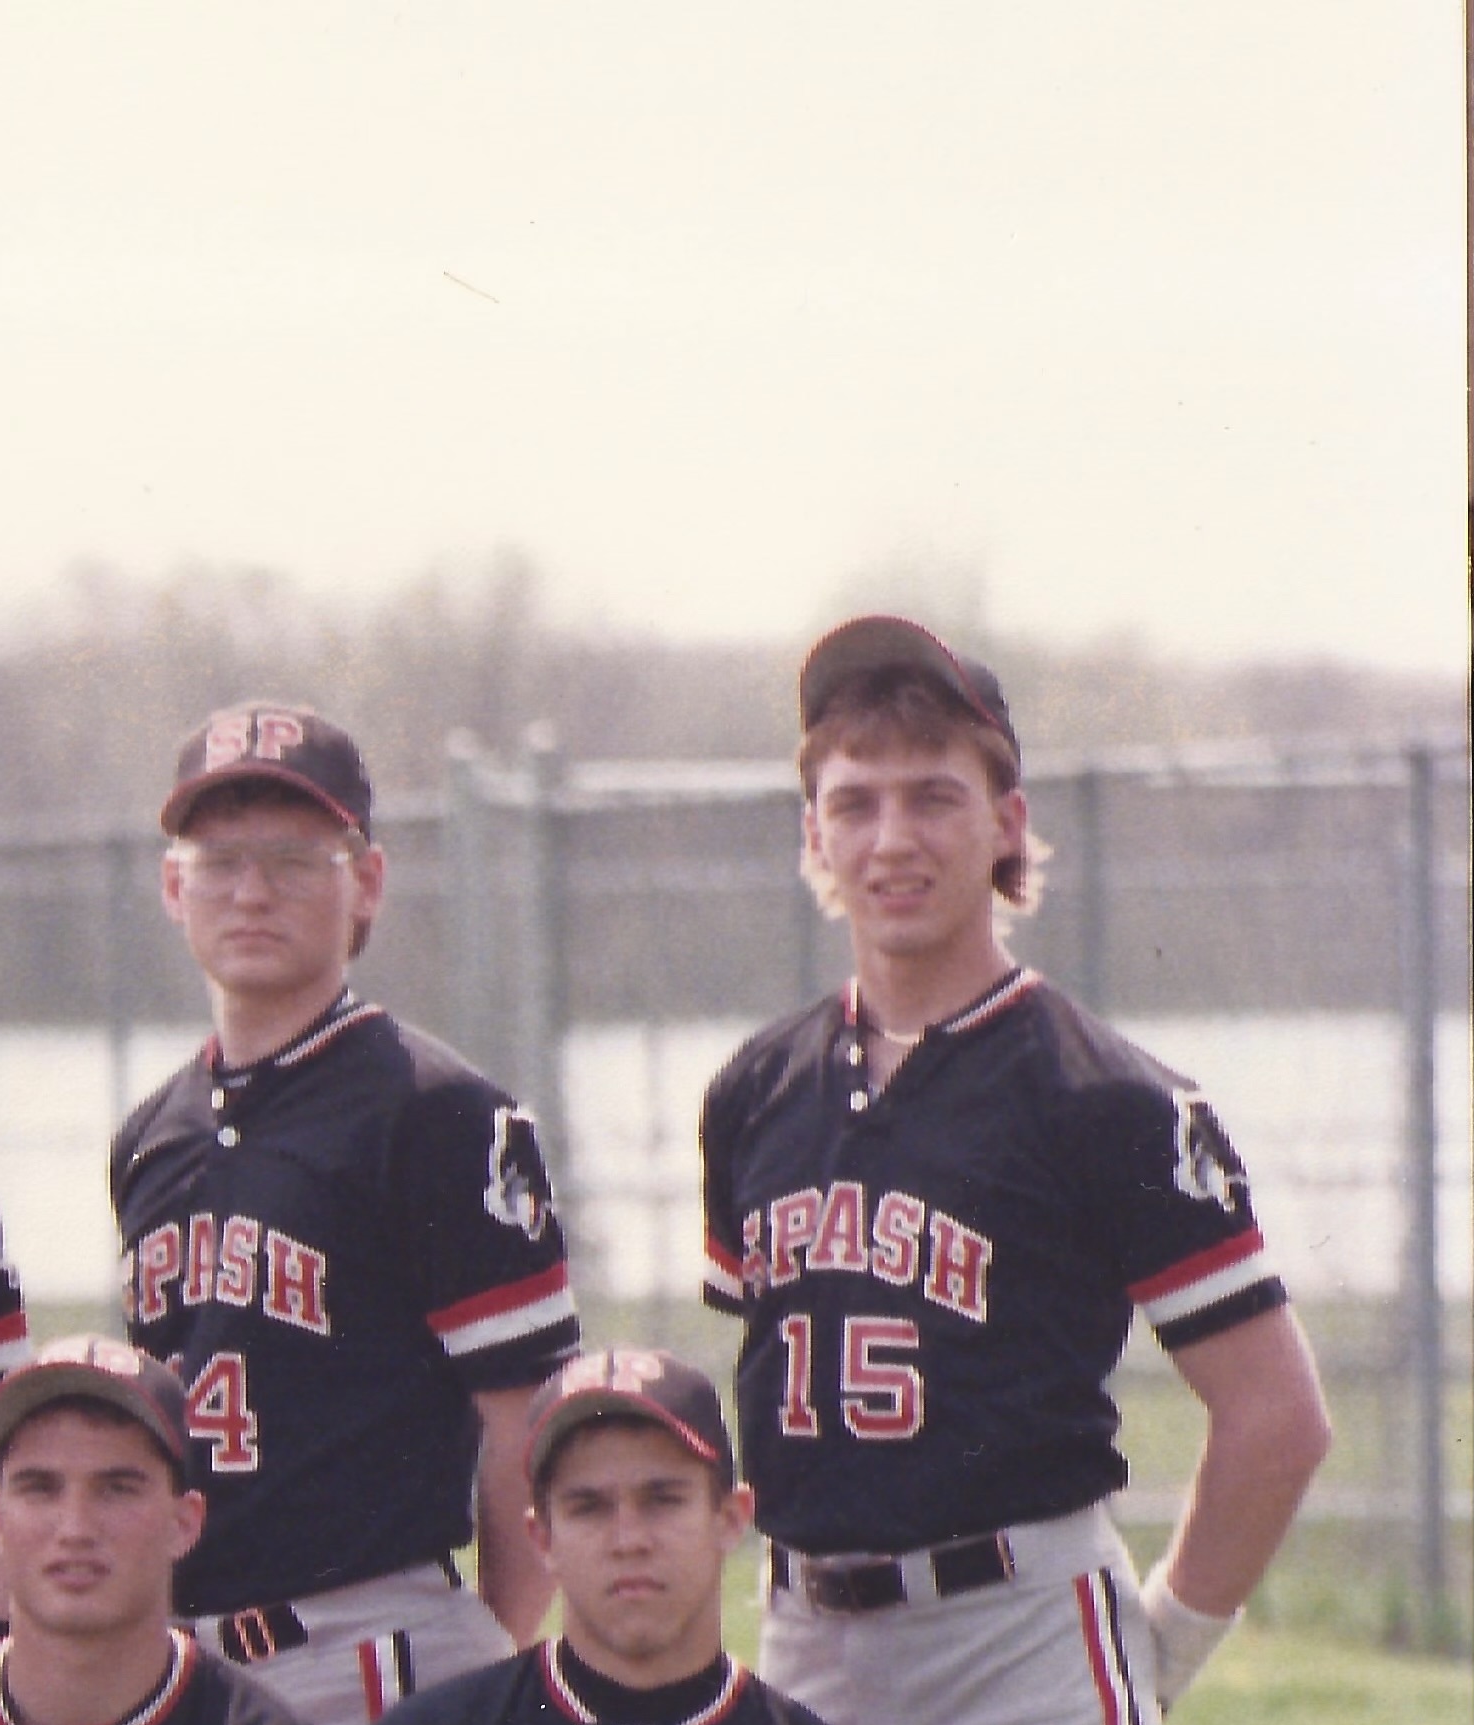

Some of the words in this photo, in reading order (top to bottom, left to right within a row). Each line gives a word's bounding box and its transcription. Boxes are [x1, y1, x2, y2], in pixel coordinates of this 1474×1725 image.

[205, 712, 305, 771] SP
[121, 1211, 331, 1338] PASH
[780, 1312, 924, 1441] 15
